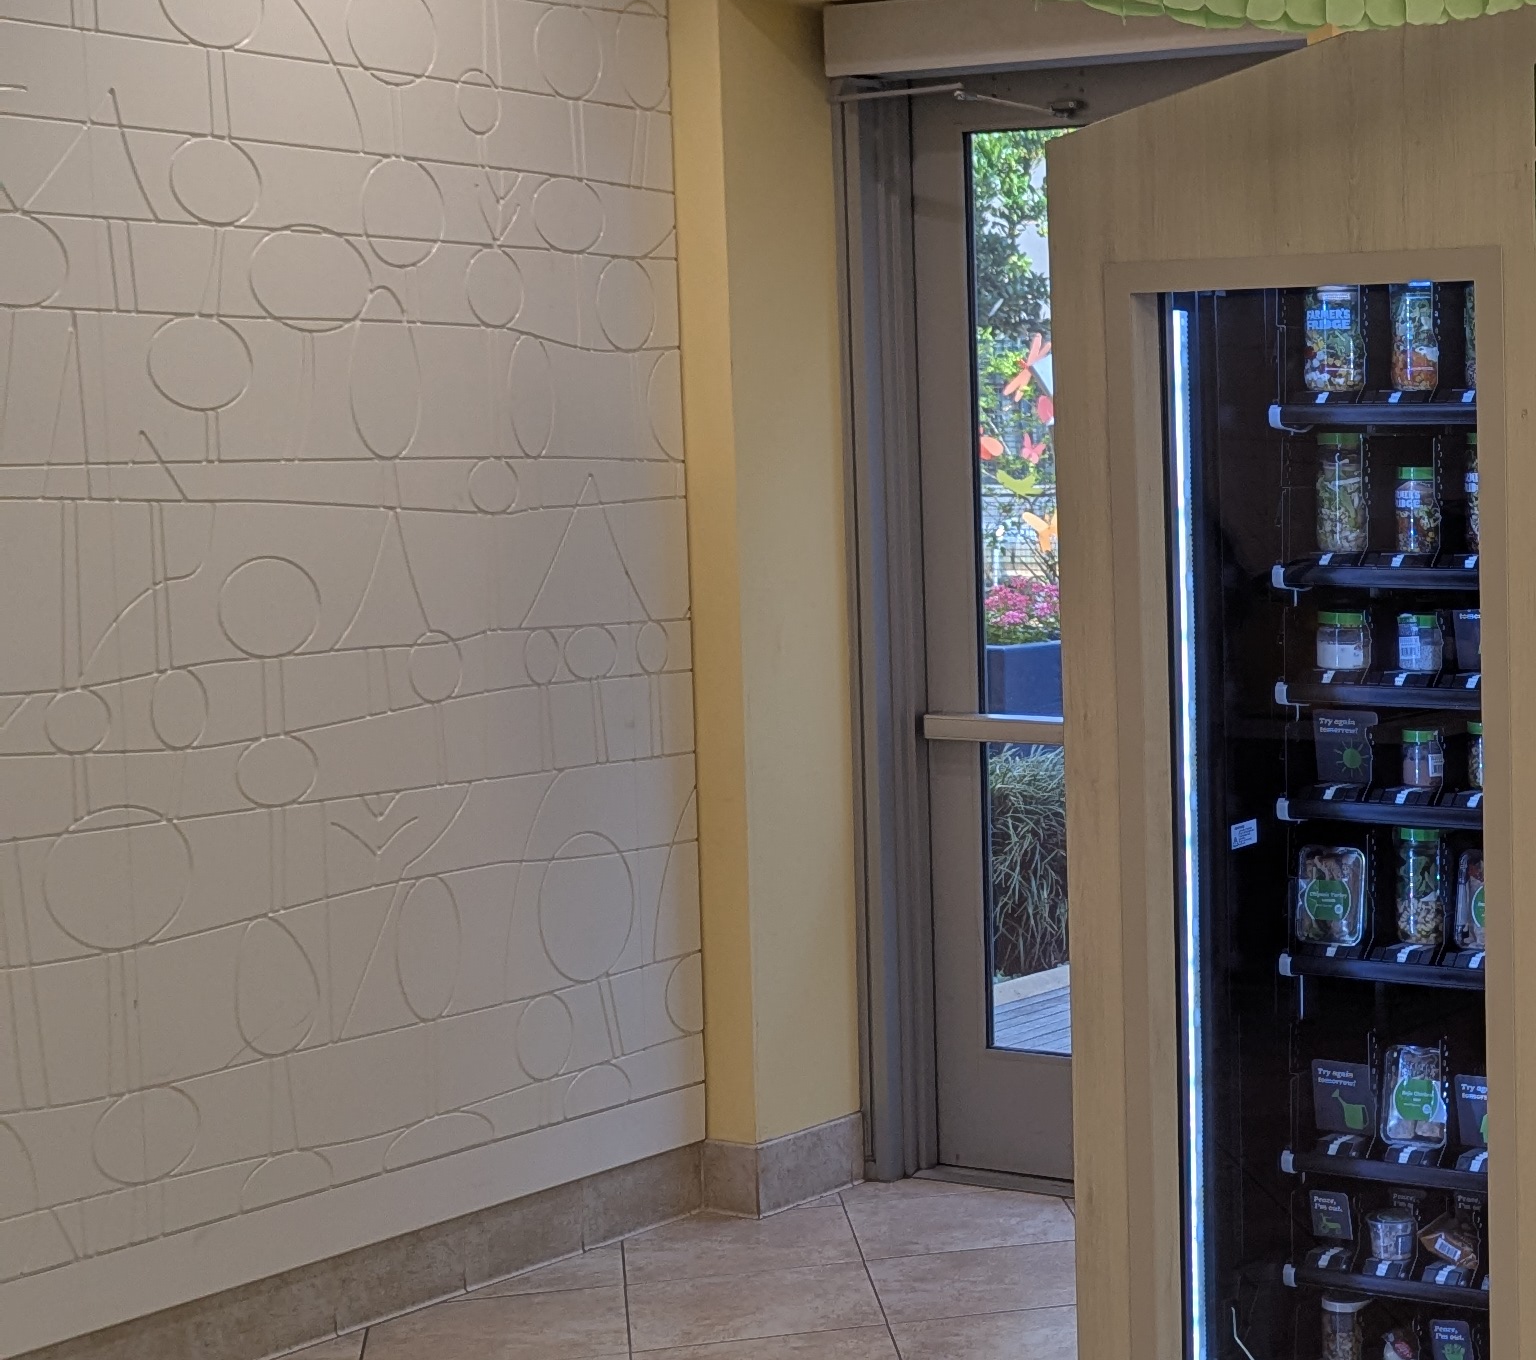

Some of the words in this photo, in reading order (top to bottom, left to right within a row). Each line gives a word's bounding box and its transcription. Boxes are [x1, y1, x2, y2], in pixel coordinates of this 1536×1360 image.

[1307, 308, 1351, 320] FARMER'S
[1307, 320, 1351, 330] FRIDGE
[1318, 1068, 1331, 1077] Try
